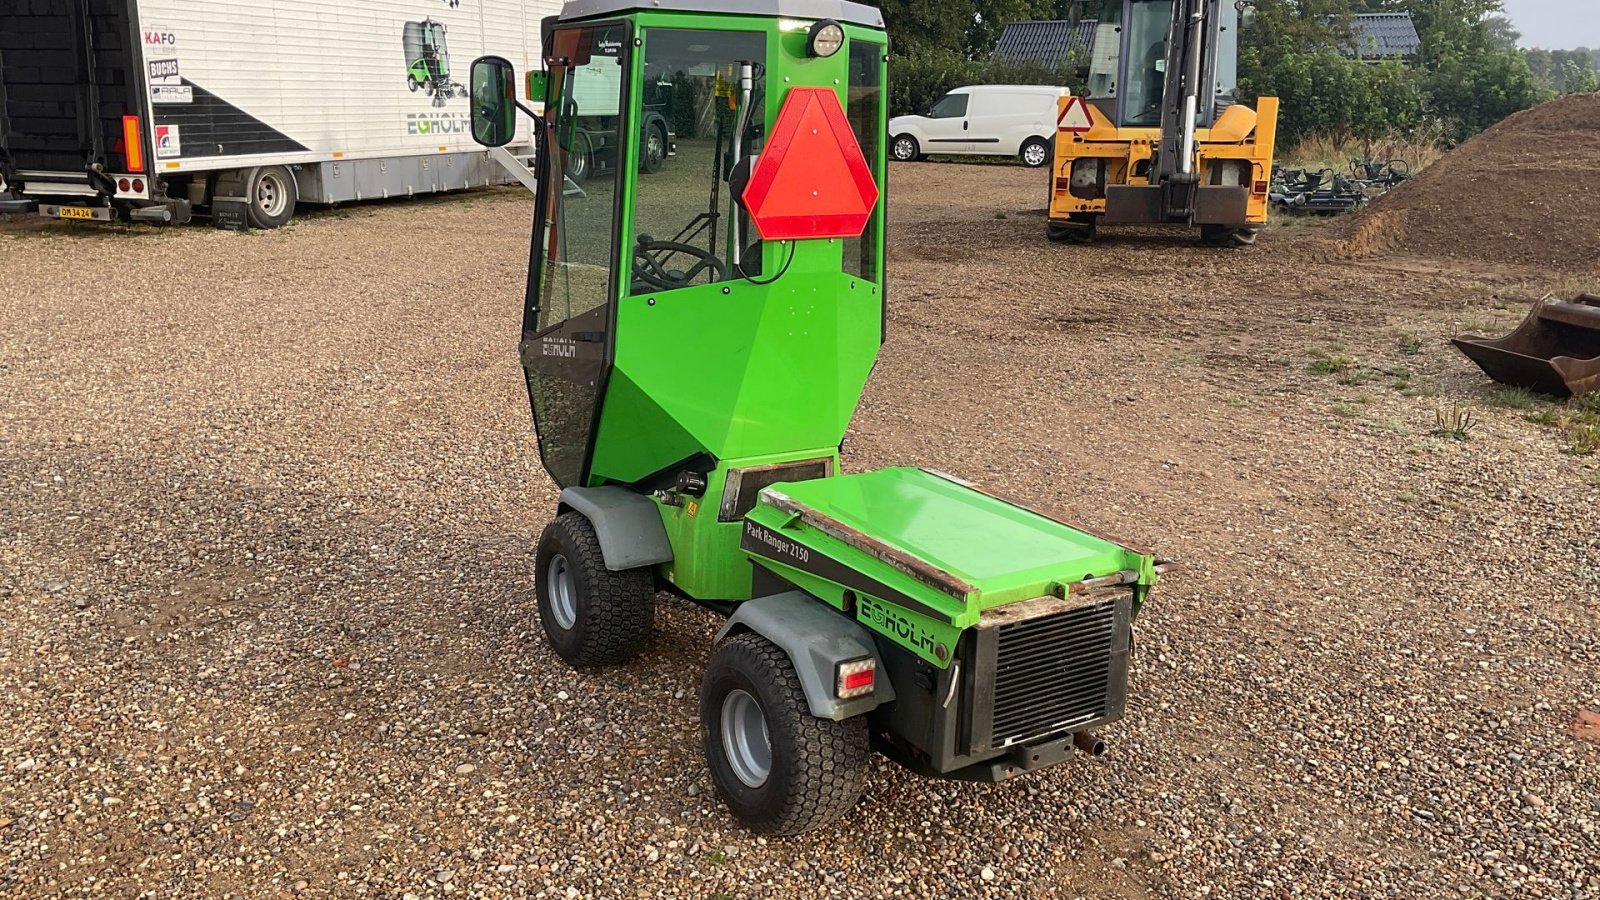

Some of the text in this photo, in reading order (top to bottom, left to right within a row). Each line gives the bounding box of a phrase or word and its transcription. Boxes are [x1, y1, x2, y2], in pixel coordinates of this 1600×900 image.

[145, 32, 175, 45] KAFO
[150, 61, 177, 76] BUCHS
[407, 113, 471, 134] EGHOLM
[747, 522, 809, 563] Park Ranger 2150
[862, 596, 935, 654] EGHOLM
